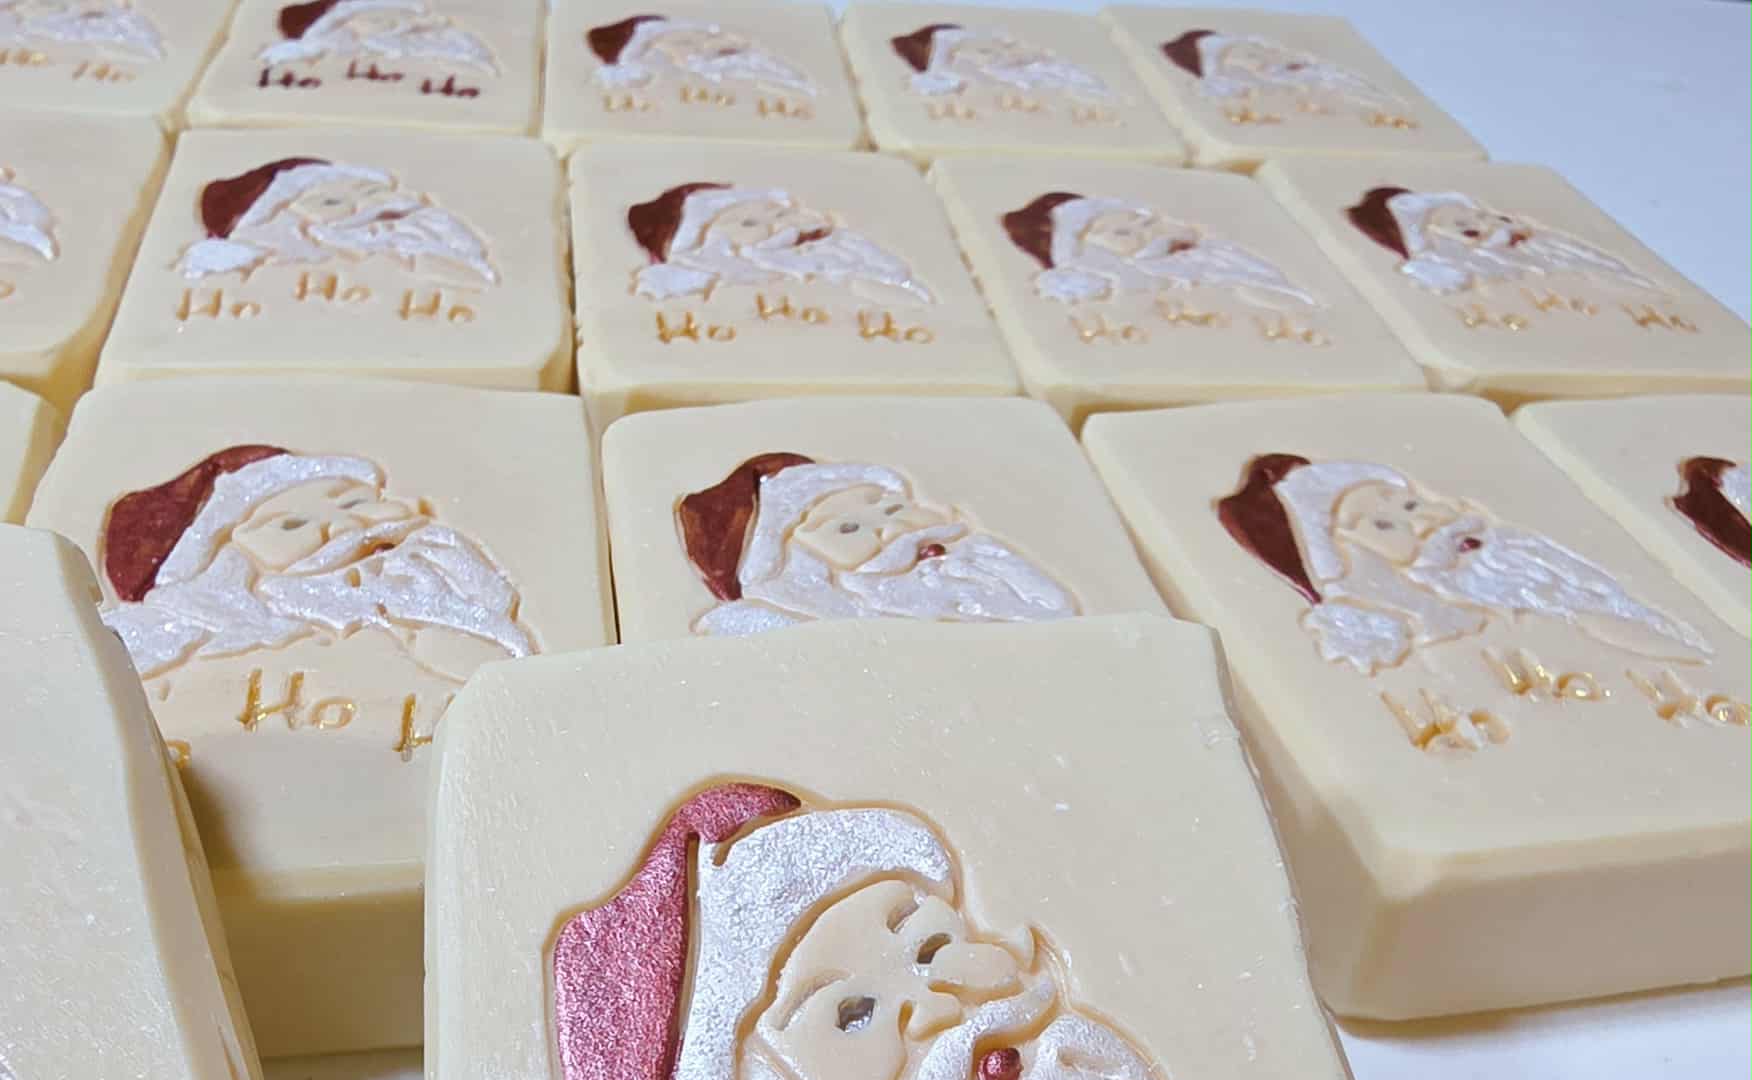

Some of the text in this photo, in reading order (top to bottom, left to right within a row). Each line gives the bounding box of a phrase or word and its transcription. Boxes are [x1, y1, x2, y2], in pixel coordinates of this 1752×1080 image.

[176, 272, 477, 324] Ho Ho Ho
[655, 292, 936, 344] Ho Ho Ho
[235, 667, 358, 732] Ho
[1379, 647, 1751, 752] Ho Ho Ho
